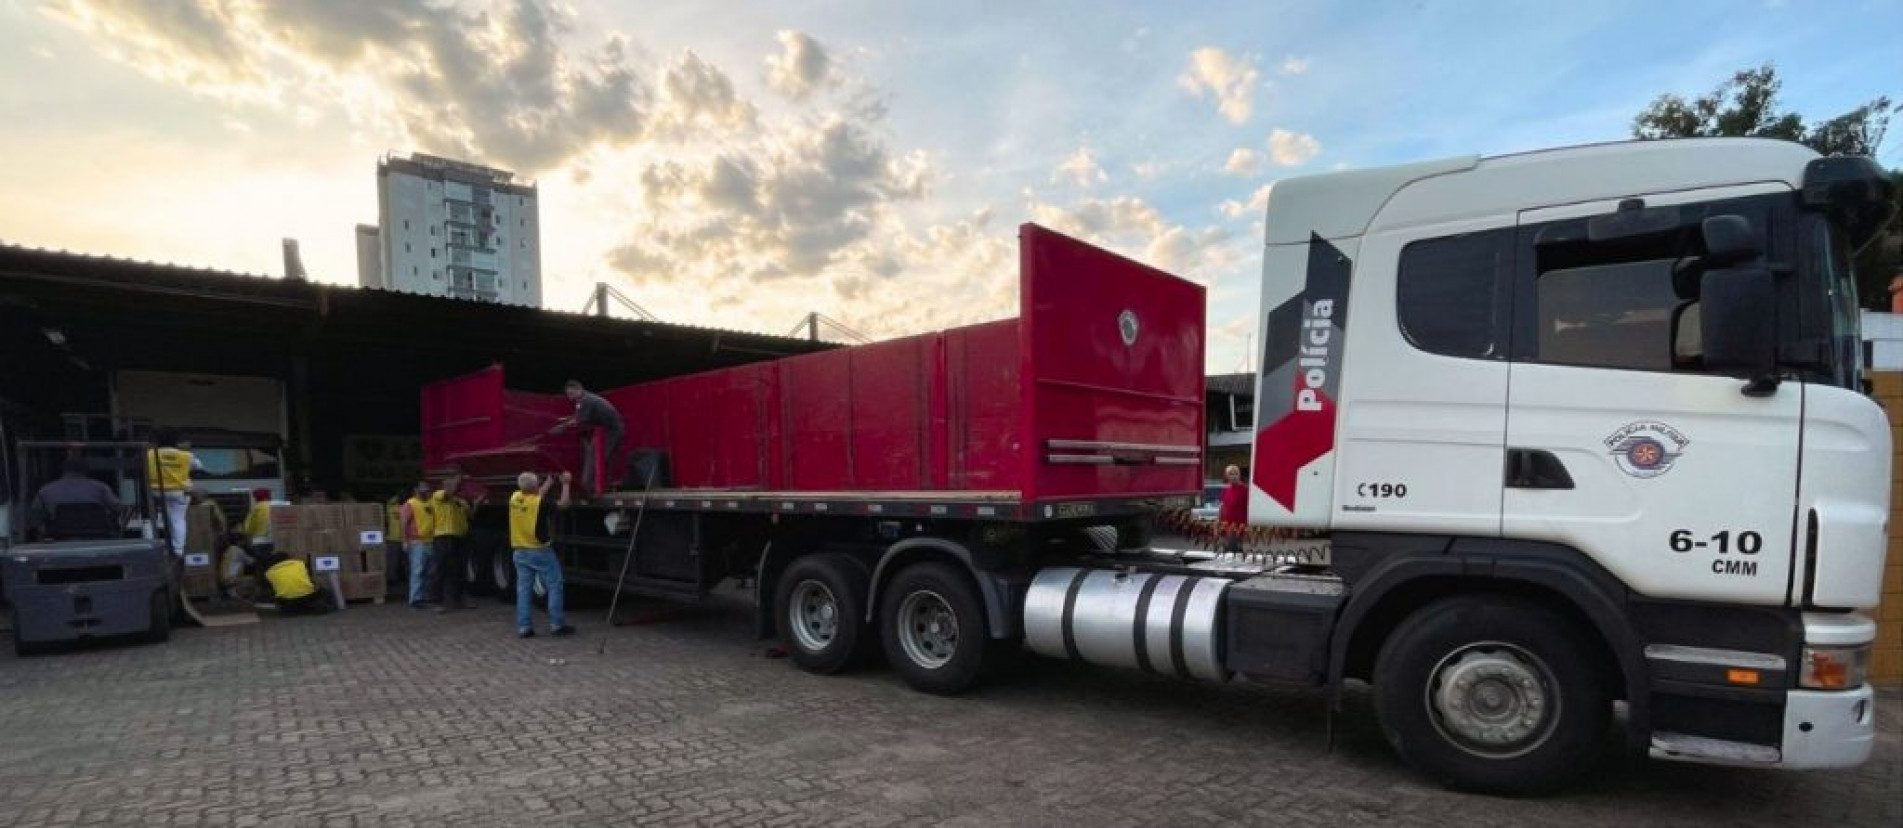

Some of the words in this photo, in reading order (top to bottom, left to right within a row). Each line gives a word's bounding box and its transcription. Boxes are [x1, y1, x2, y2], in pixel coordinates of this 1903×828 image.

[1297, 299, 1333, 410] Polícia
[1368, 482, 1407, 498] 190
[1669, 529, 1763, 555] 6-10
[1712, 559, 1758, 576] CMM
